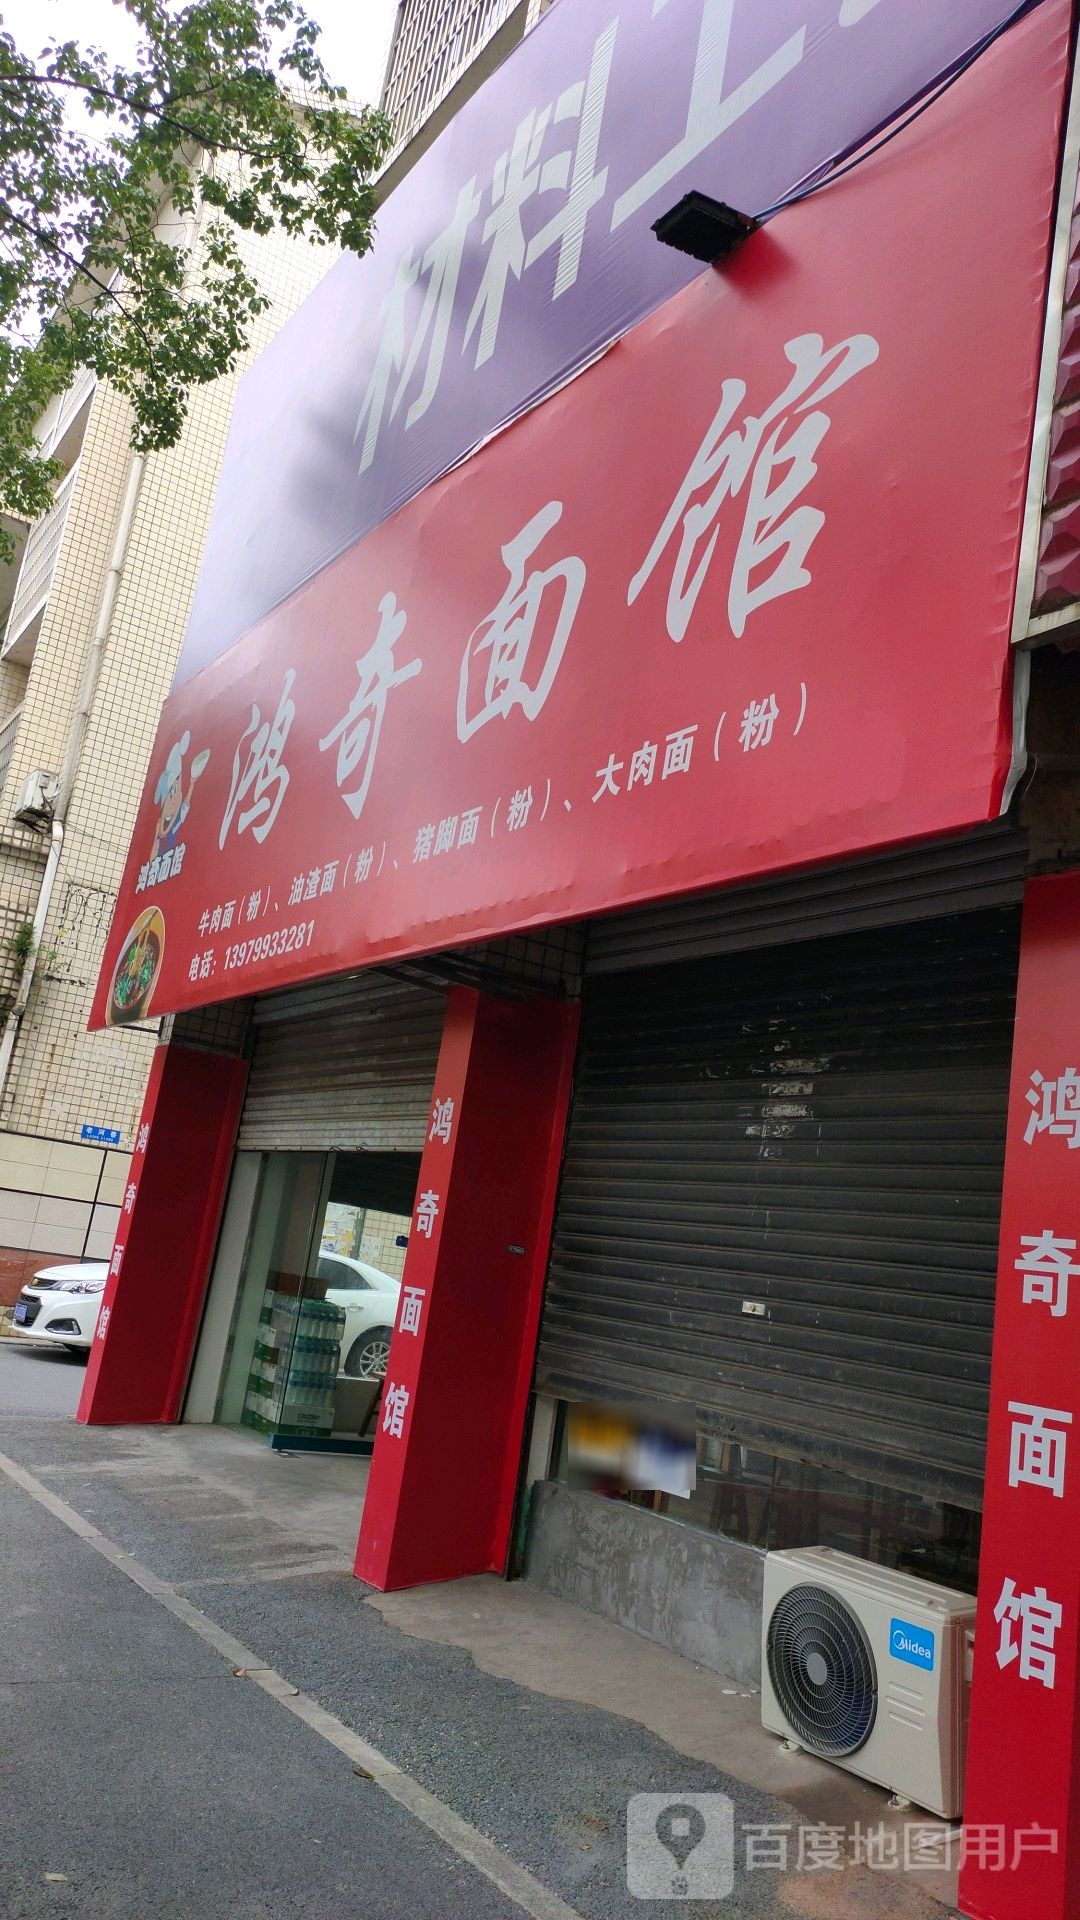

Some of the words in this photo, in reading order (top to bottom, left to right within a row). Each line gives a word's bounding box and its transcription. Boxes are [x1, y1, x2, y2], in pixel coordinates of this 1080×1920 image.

[219, 333, 878, 851] 鸿奇面馆
[135, 842, 186, 894] 鸿奇面馆
[96, 1122, 149, 1341] 鸿奇面馆
[382, 1098, 455, 1439] 鸿奇面馆
[994, 1066, 1080, 1690] 鸿奇面馆
[893, 1629, 931, 1659] Midea
